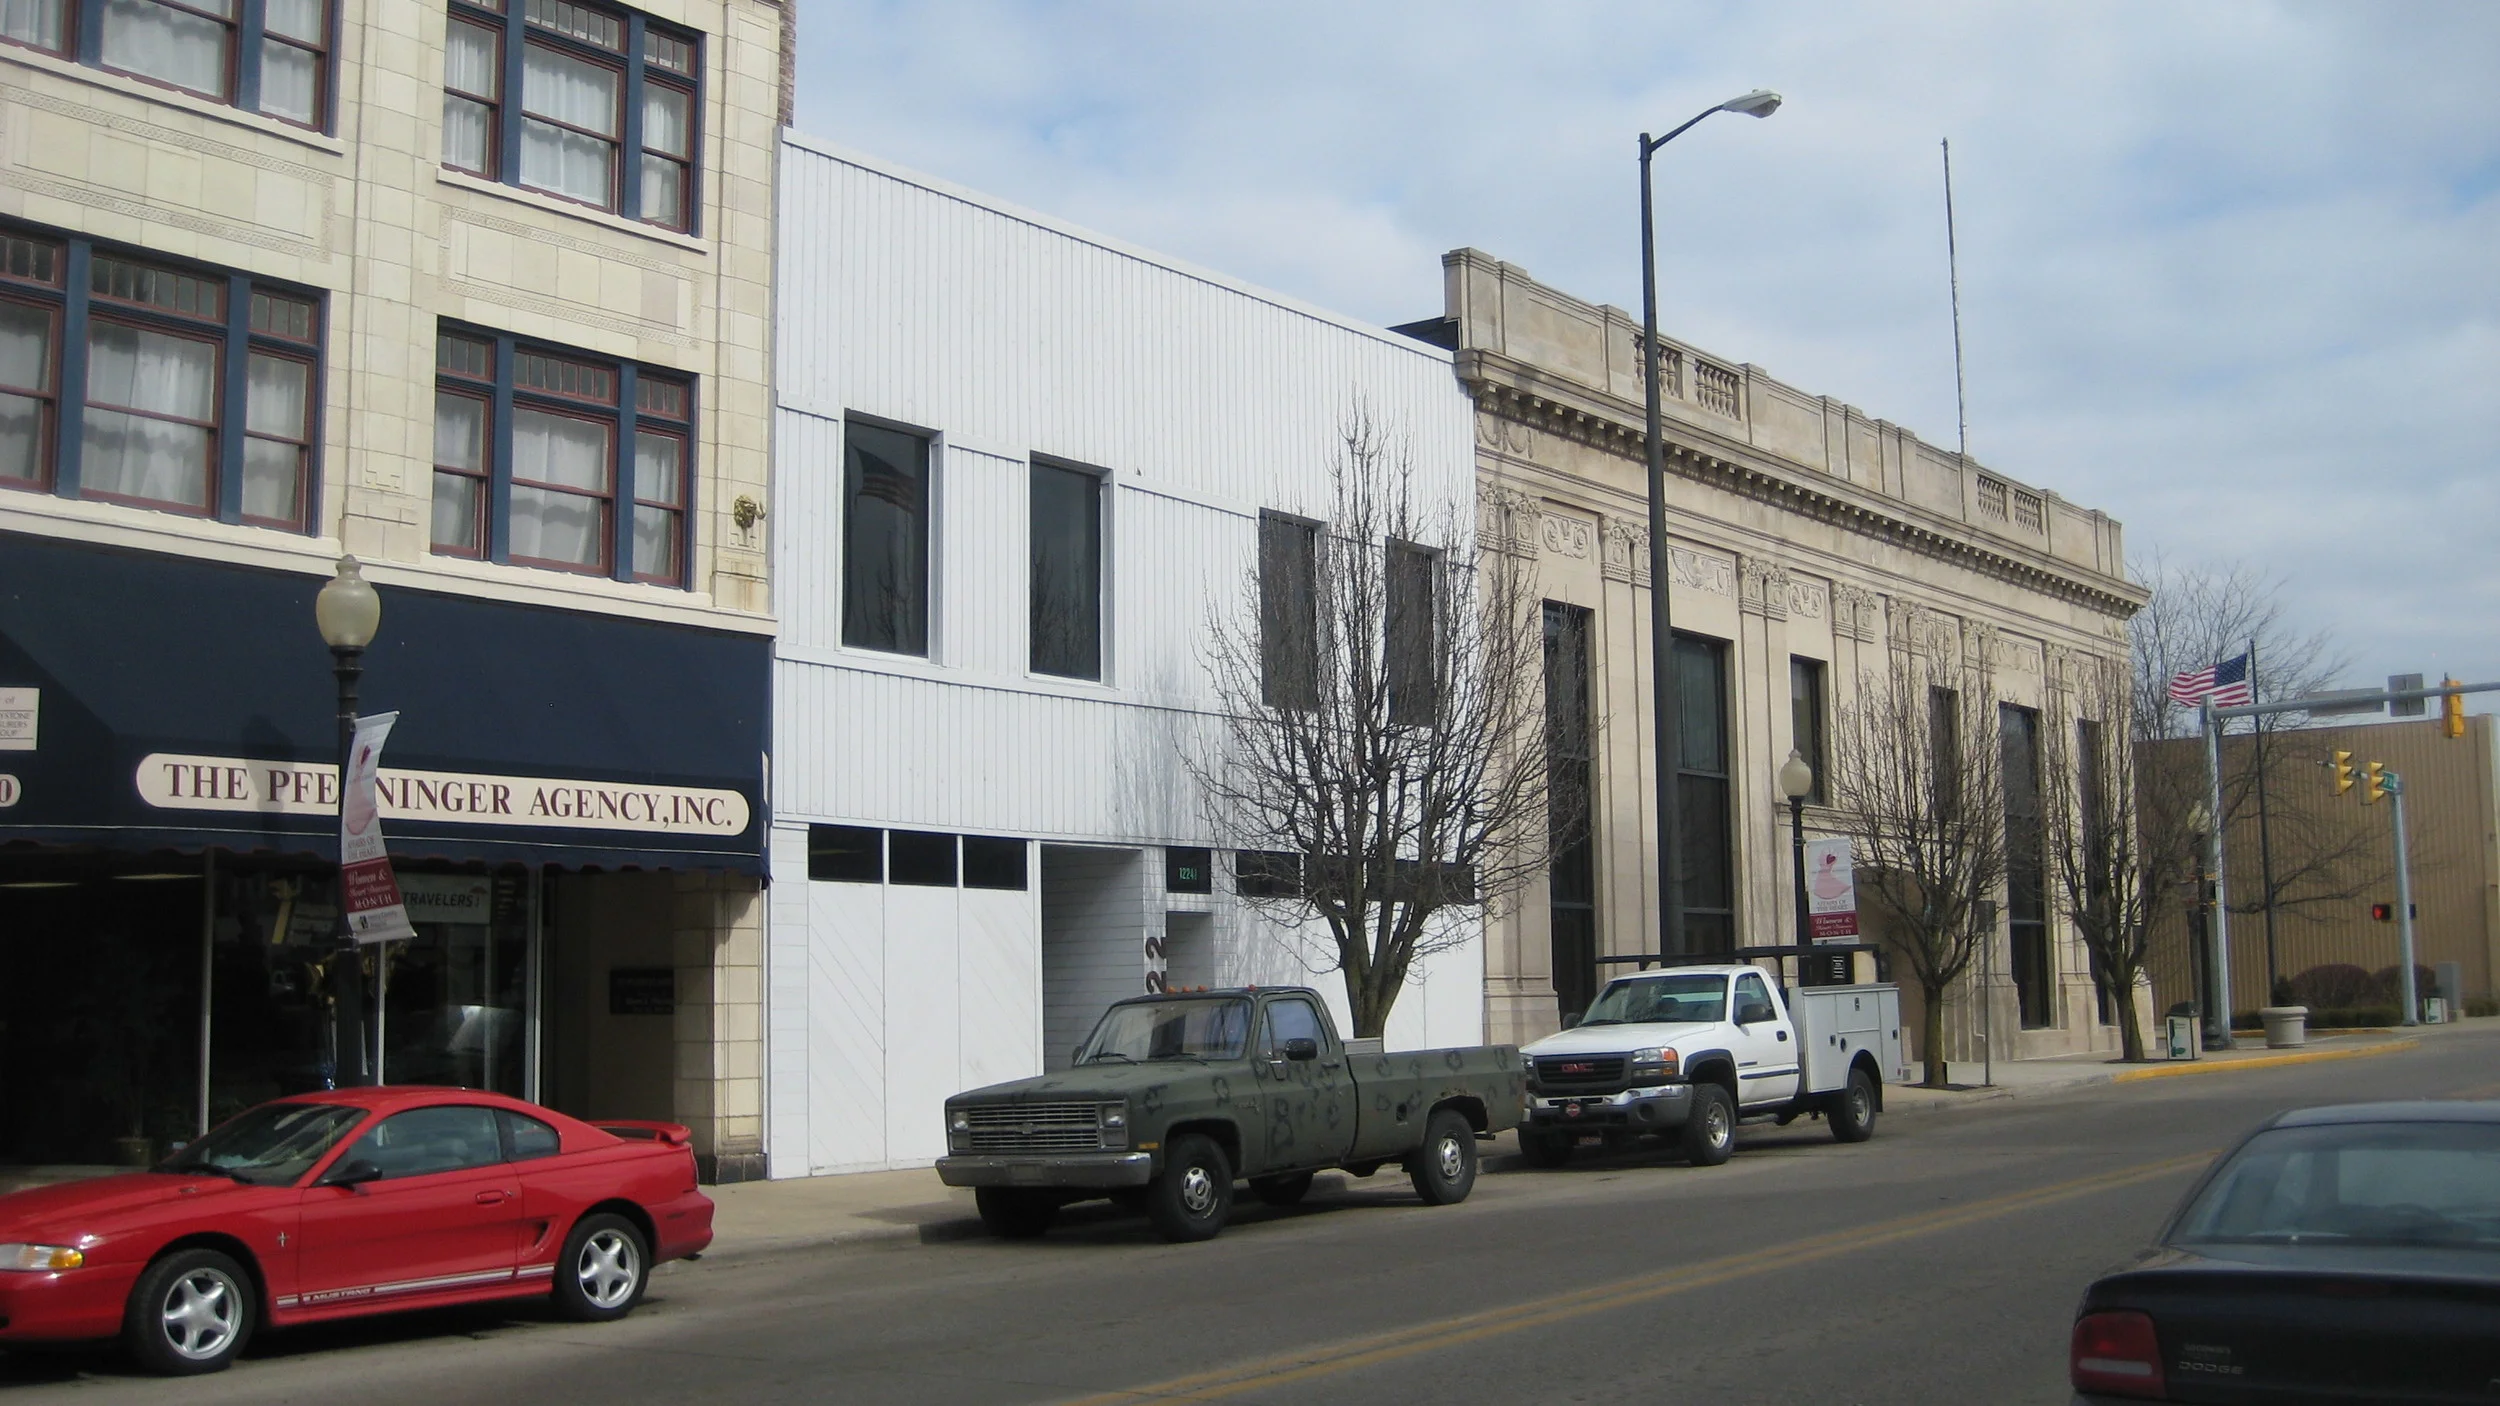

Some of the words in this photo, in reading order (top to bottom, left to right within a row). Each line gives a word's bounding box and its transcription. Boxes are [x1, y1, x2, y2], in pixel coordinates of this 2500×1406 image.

[163, 763, 249, 800] THE
[266, 769, 512, 815] PFENINGER
[354, 892, 393, 909] MONTH
[402, 891, 473, 908] TRAVELERS
[1561, 1063, 1594, 1073] GMC
[2178, 1361, 2245, 1375] DODGE
